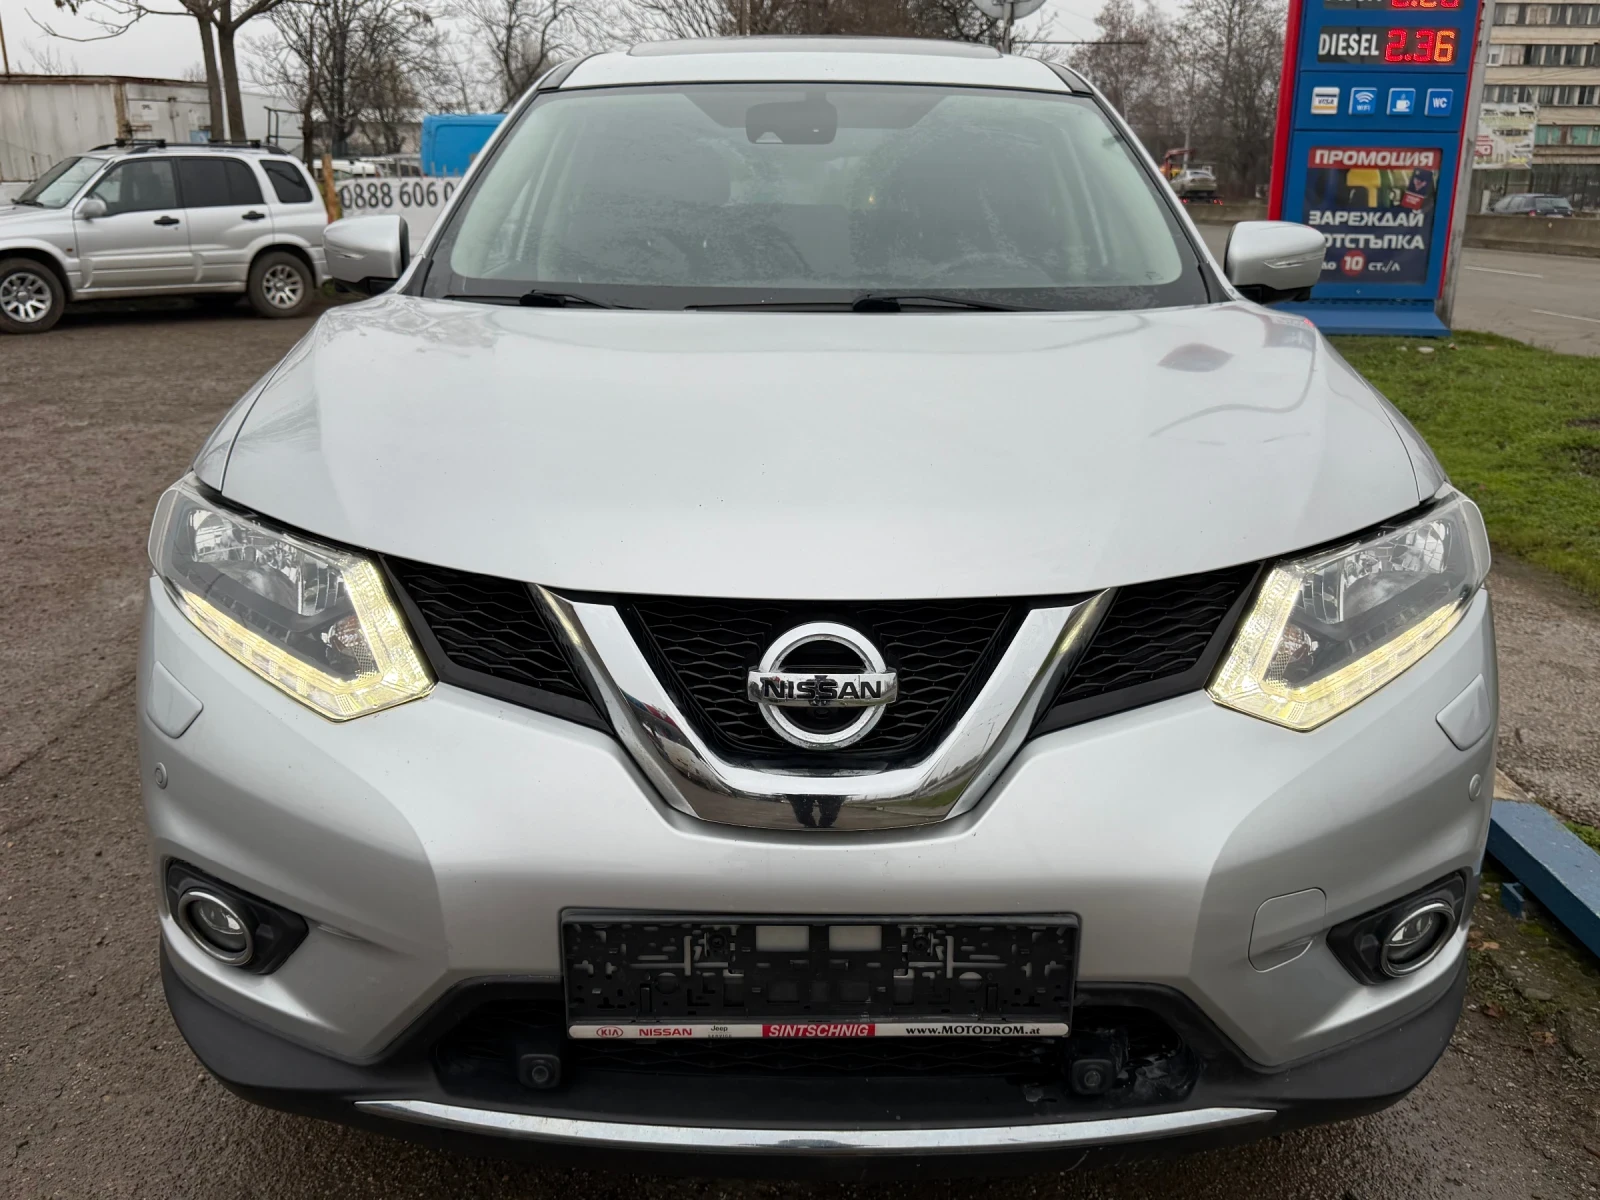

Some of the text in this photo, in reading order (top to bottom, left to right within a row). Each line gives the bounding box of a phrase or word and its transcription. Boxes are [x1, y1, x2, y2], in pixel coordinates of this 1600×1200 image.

[1318, 29, 1456, 62] DIESEL 2.36
[1432, 97, 1448, 108] WC
[1314, 149, 1434, 167] ПРОМОЦИЯ
[341, 182, 393, 209] 0888
[400, 181, 438, 208] 606
[1308, 209, 1425, 227] ЗАРЕЖДАЙ
[1343, 255, 1364, 271] 10
[763, 680, 882, 699] NISSAN
[639, 1028, 692, 1037] NISSAN
[768, 1024, 869, 1037] SINTSCHNIG
[905, 1025, 1041, 1036] www.MOTODROM.at
